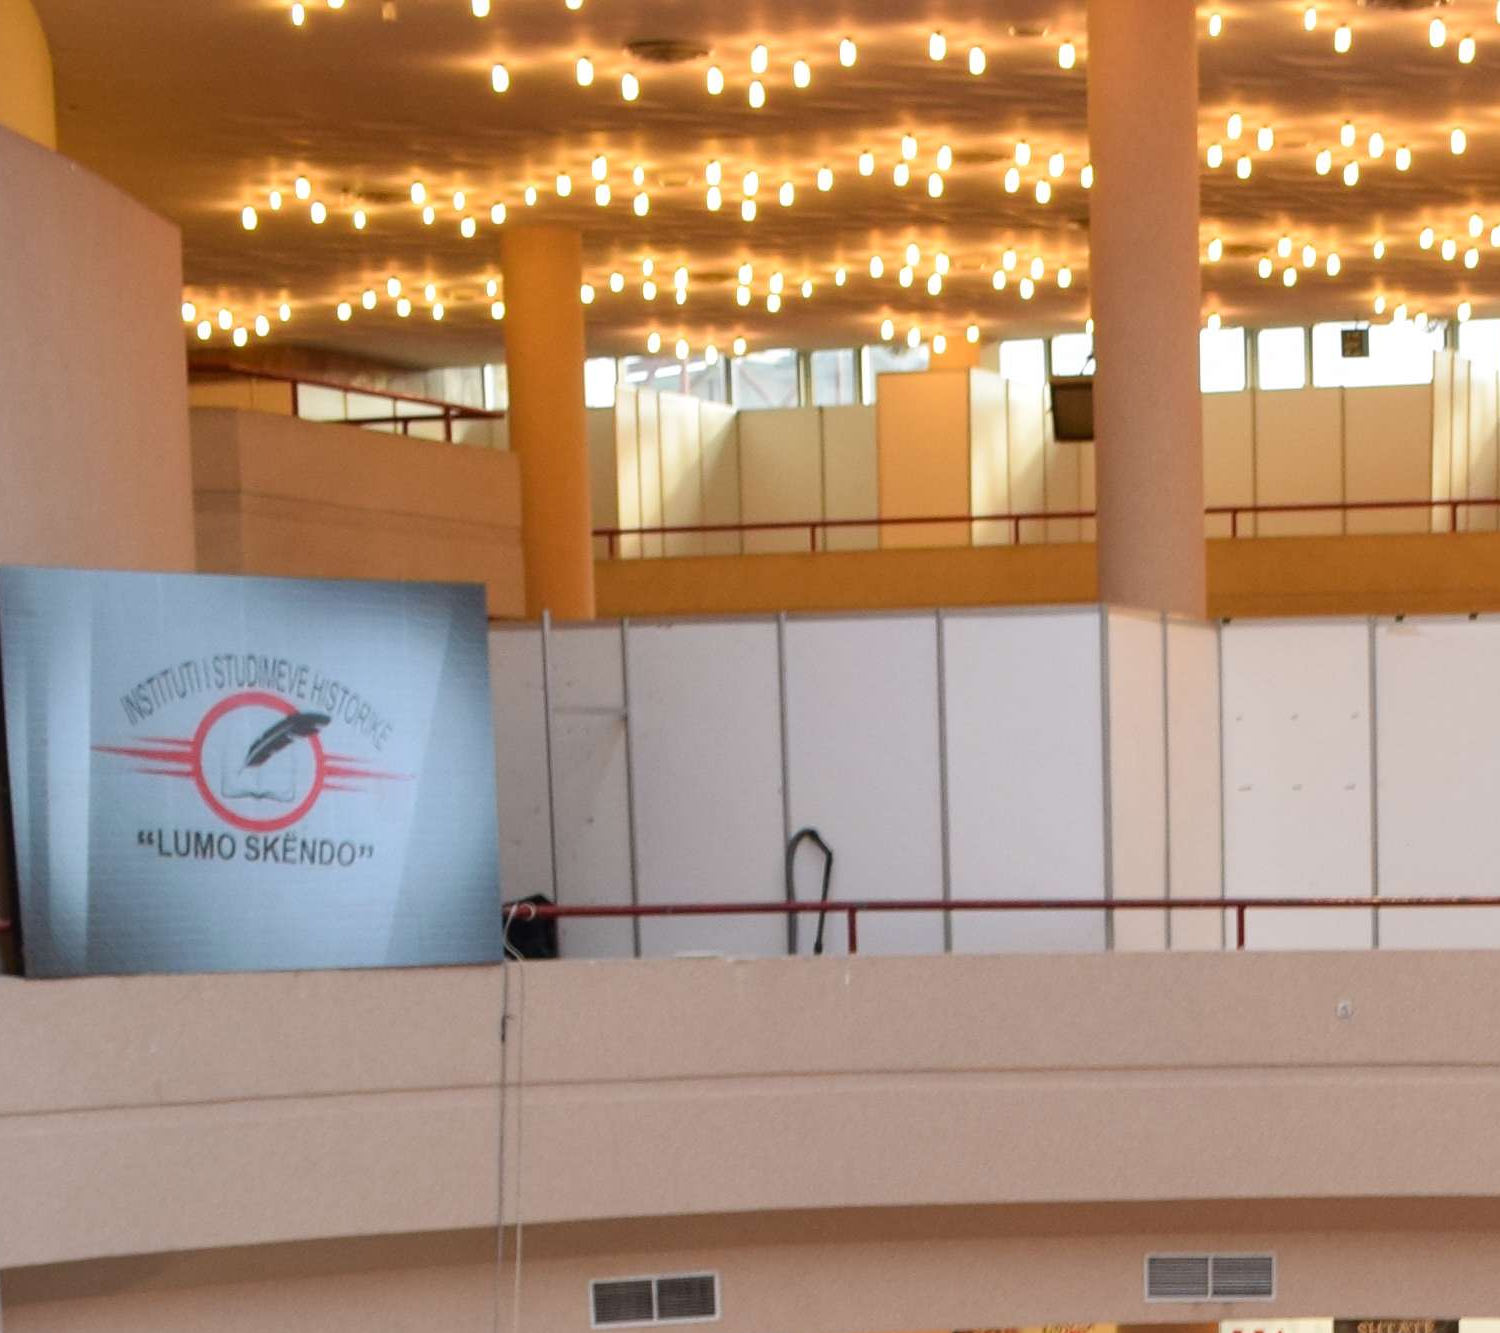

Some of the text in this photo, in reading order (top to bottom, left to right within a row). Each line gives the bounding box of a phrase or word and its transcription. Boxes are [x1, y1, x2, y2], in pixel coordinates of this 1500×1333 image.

[121, 661, 201, 727] INSTITUTI
[213, 652, 309, 698] STUDIMEVE
[313, 672, 393, 750] HISTORIKE
